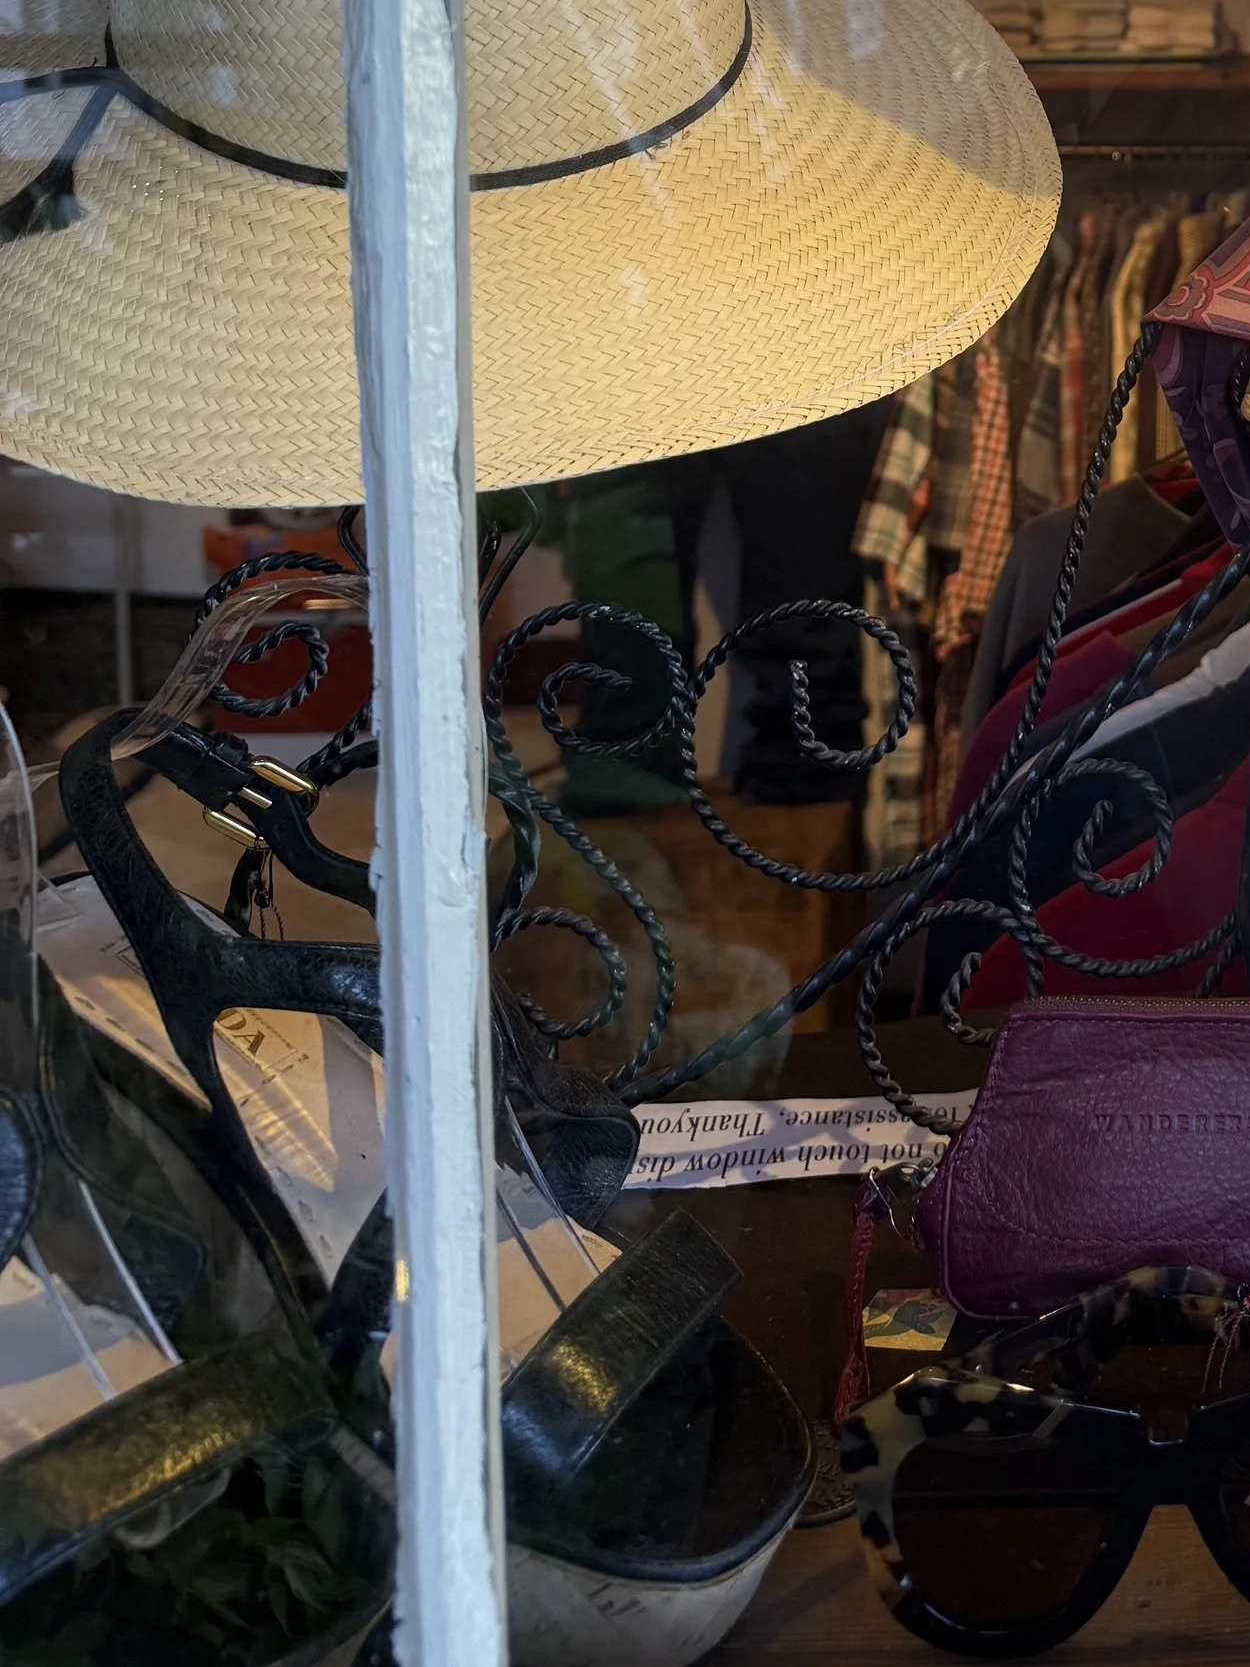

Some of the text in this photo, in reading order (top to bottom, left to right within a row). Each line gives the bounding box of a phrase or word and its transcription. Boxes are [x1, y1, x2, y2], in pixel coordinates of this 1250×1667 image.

[640, 1107, 765, 1142] Thankyou
[683, 1145, 787, 1180] window
[799, 1142, 870, 1171] touch
[880, 1141, 922, 1164] not
[631, 1155, 675, 1183] dis
